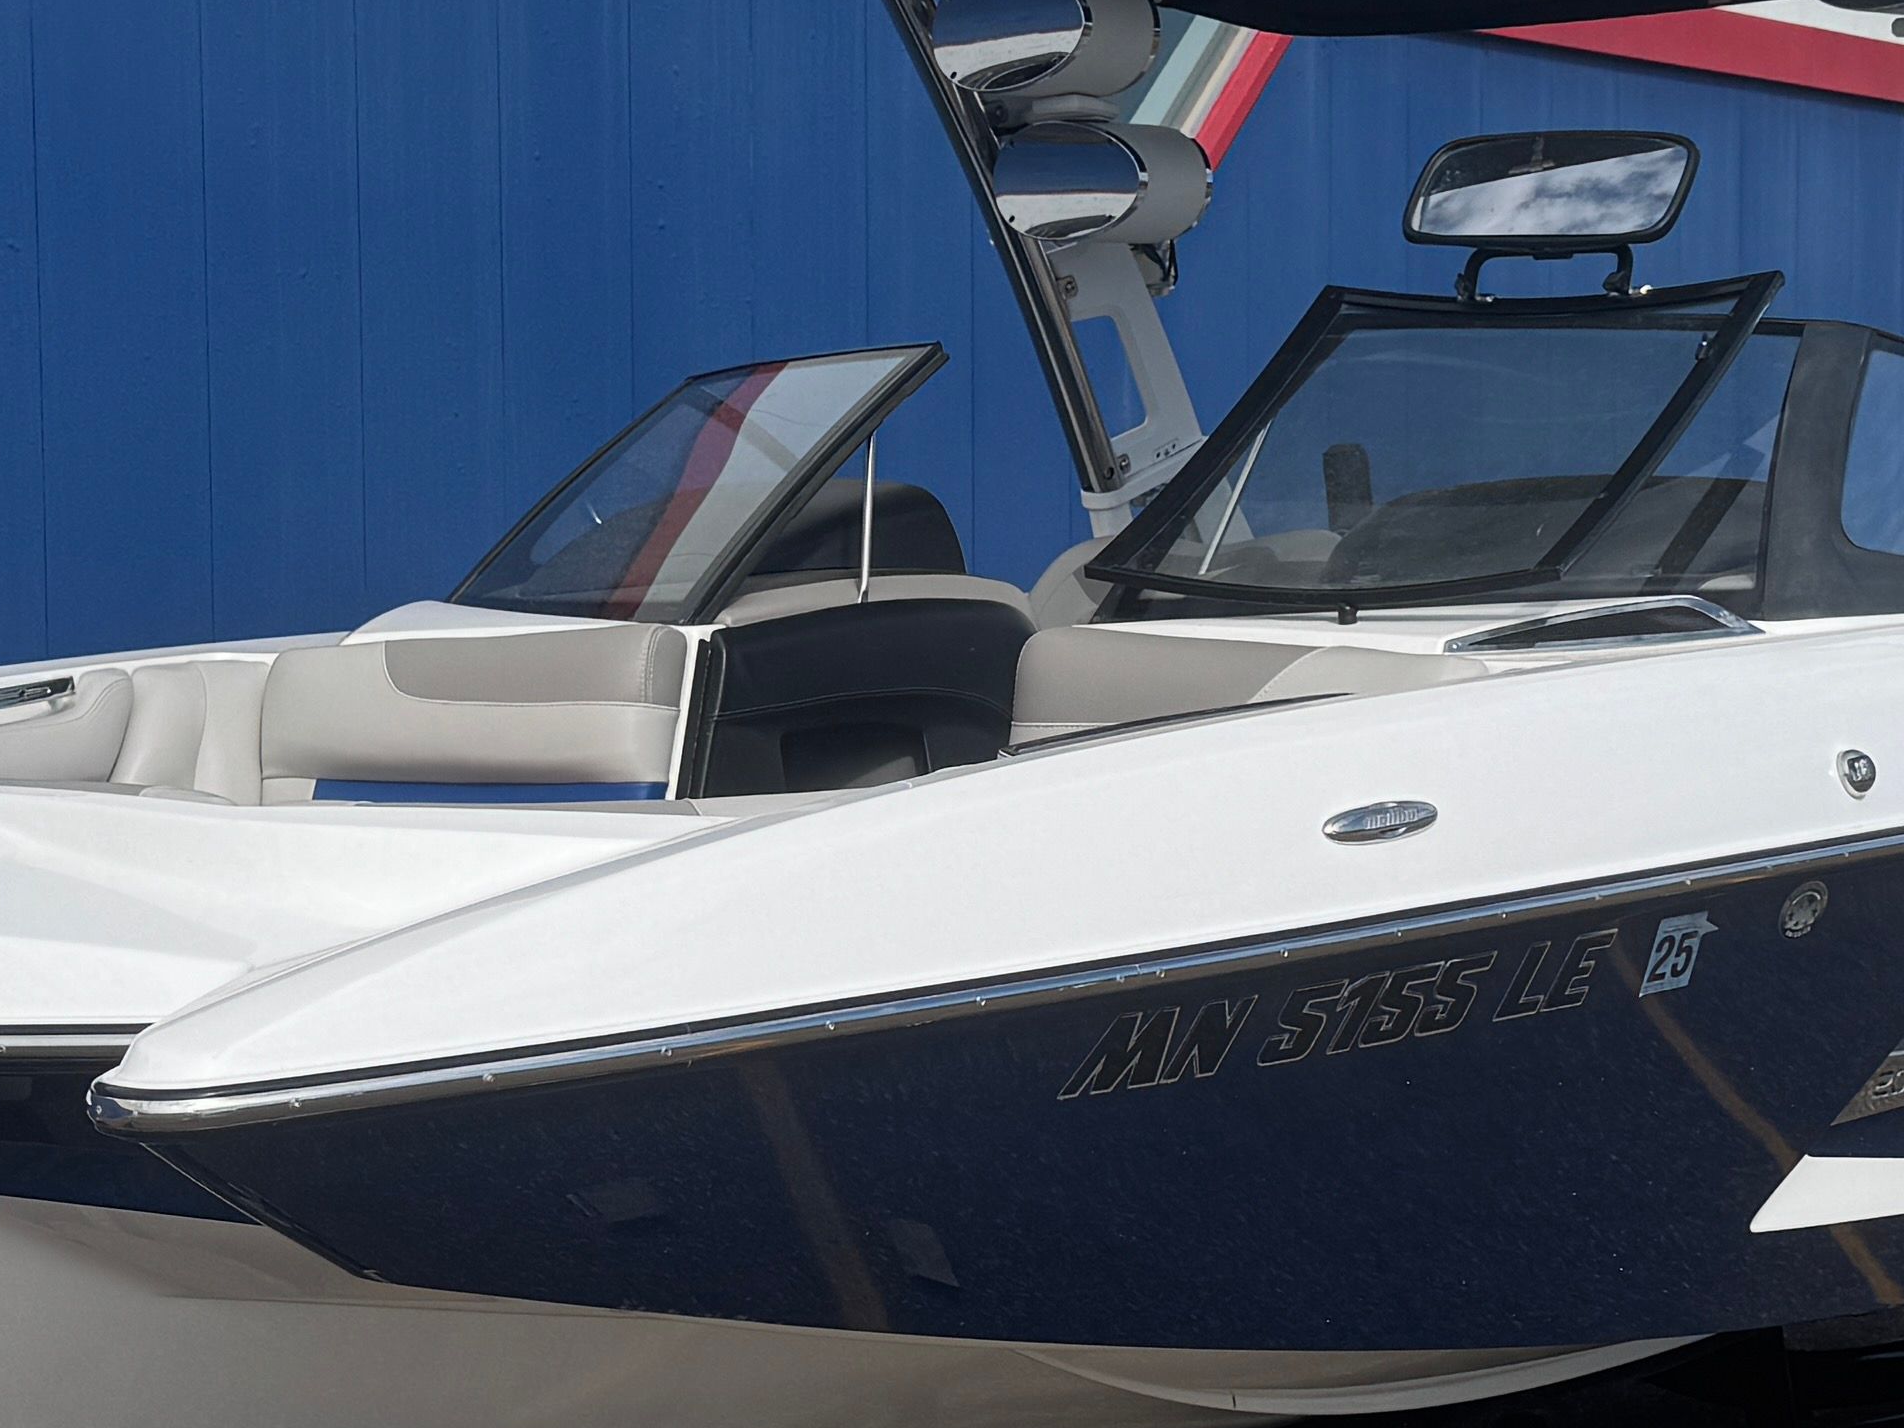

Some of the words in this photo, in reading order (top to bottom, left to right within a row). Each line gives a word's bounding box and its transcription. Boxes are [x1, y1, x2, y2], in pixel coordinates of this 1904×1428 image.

[1647, 931, 1695, 983] 25
[1056, 993, 1259, 1100] MN
[1256, 949, 1498, 1067] 5155
[1493, 927, 1619, 1023] LE
